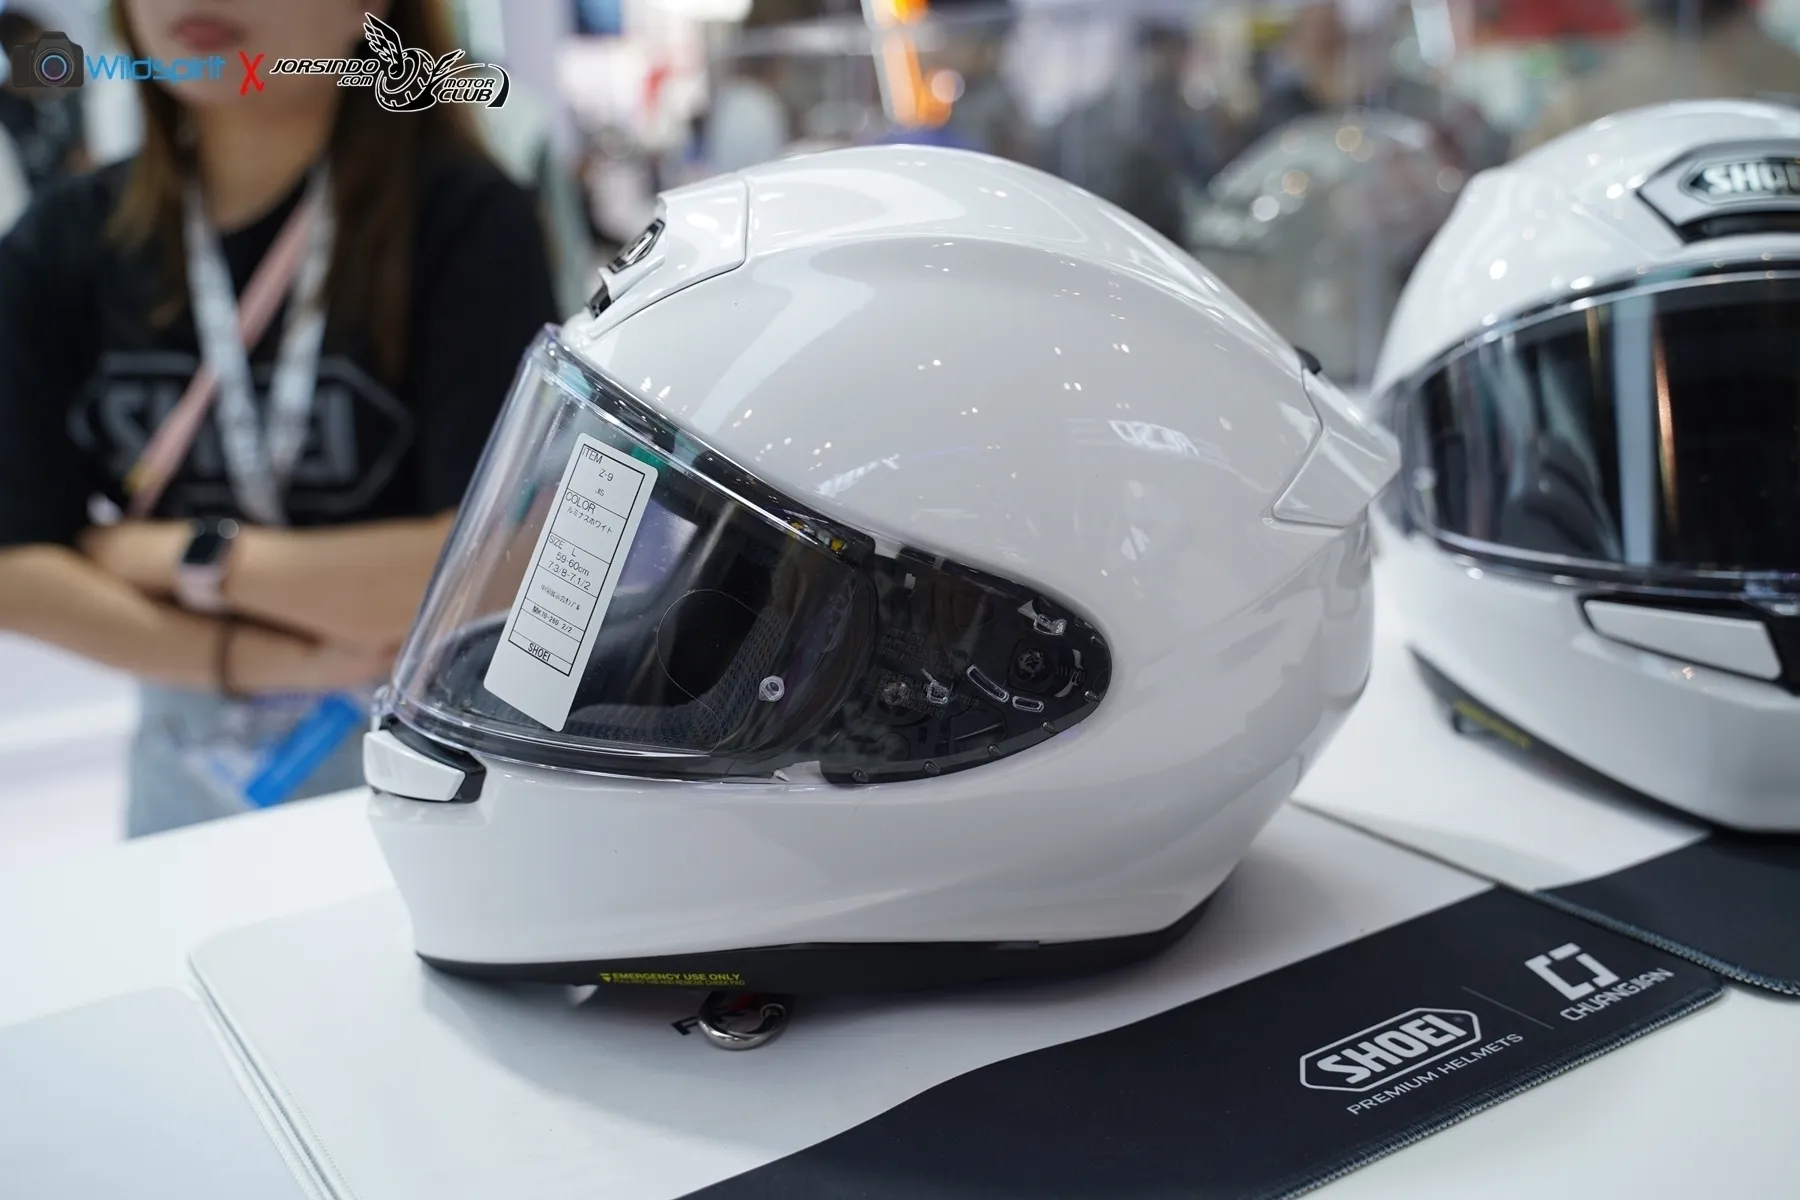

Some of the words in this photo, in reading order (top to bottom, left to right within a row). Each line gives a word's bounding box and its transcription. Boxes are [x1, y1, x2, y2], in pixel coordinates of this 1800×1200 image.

[582, 446, 603, 464] ITEM
[598, 468, 614, 482] Z-9
[565, 491, 596, 514] COLOR
[548, 534, 565, 550] SIZE
[571, 547, 577, 558] L
[555, 551, 590, 577] 59-60cm
[527, 642, 551, 663] SHOEI
[612, 972, 681, 981] EMERGENCY
[683, 973, 707, 981] USE
[709, 973, 741, 982] ONLY
[1316, 1013, 1468, 1084] SHOEI
[1346, 1070, 1440, 1115] PREMIUM
[1436, 1032, 1525, 1075] HELMETS
